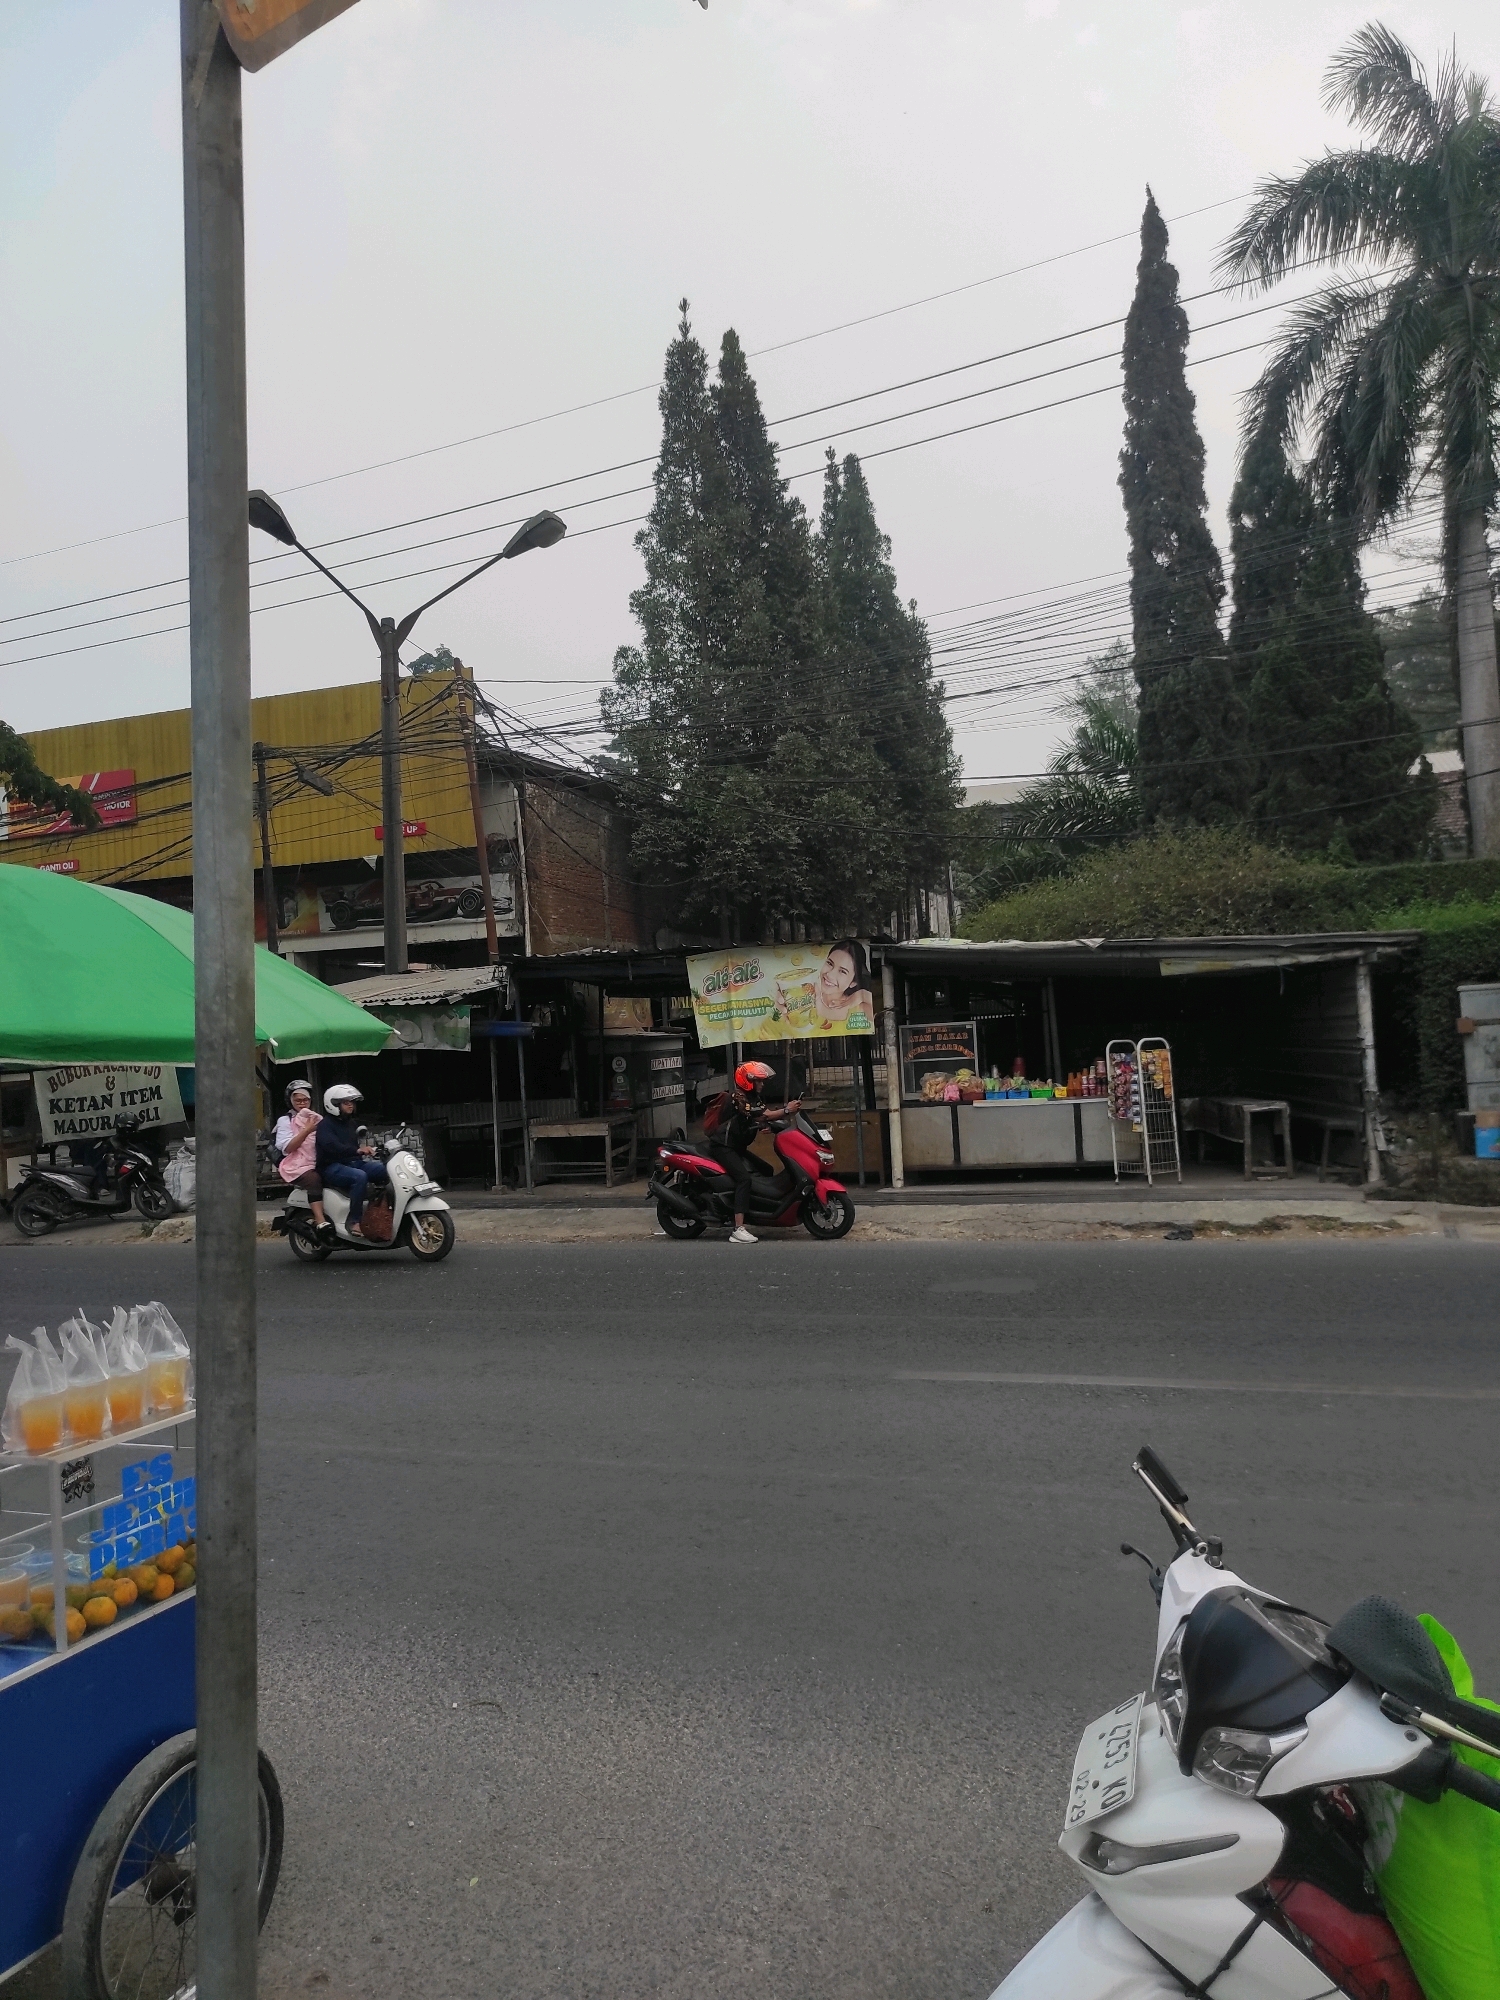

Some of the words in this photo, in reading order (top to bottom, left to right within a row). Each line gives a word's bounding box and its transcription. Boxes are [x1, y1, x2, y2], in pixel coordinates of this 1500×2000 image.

[104, 800, 131, 811] MOTOR
[406, 825, 418, 833] UP
[39, 862, 61, 872] GANTI
[62, 861, 74, 870] OLI
[699, 1003, 727, 1014] SEGER
[47, 1066, 92, 1093] BUBUR
[105, 1075, 116, 1091] &
[49, 1093, 114, 1115] KETAN
[120, 1085, 163, 1107] ITEM
[138, 1106, 161, 1124] SLI
[122, 1452, 174, 1500] ES
